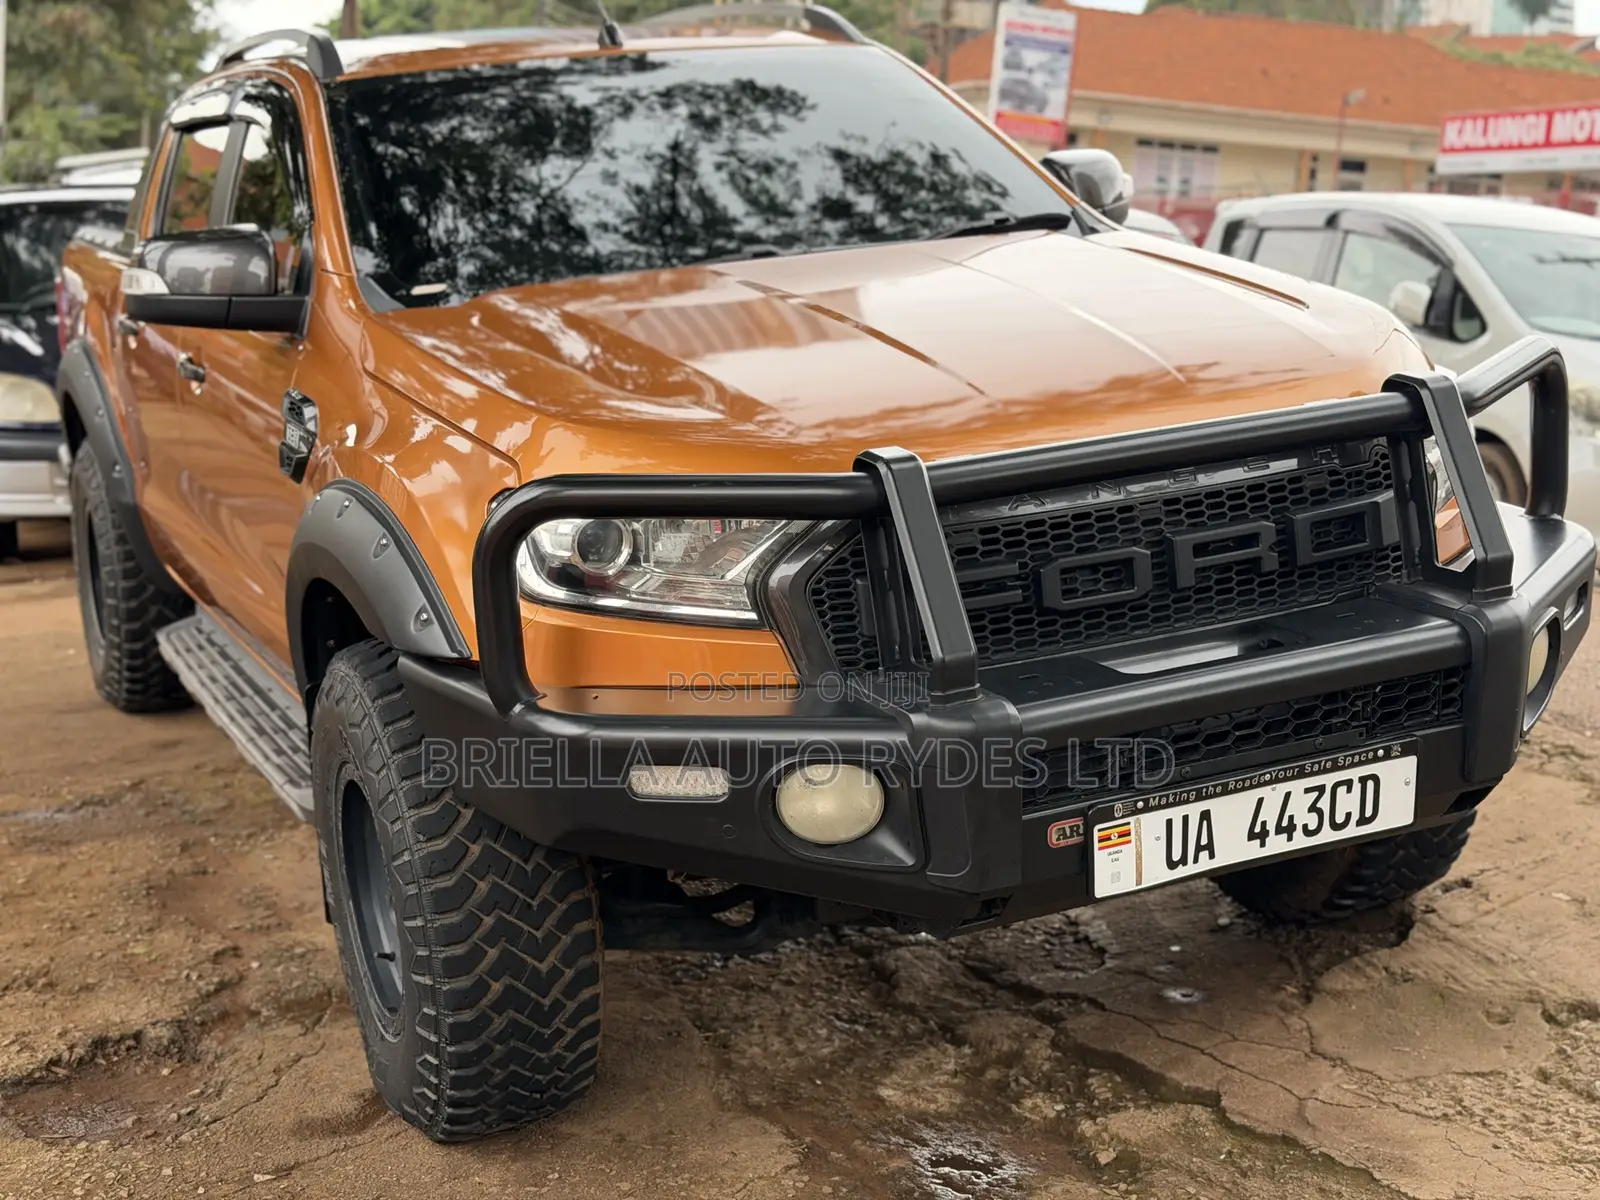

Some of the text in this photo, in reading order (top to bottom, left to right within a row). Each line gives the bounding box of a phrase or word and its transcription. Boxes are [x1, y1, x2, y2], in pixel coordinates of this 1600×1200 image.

[1444, 113, 1548, 150] KALUNGI
[1148, 791, 1197, 808] Making
[1202, 784, 1222, 797] the
[1228, 776, 1265, 791] Roads
[1271, 766, 1300, 780] Your
[1304, 760, 1332, 773] Safe
[1337, 750, 1375, 766] Space
[1165, 773, 1381, 871] UA 443CD
